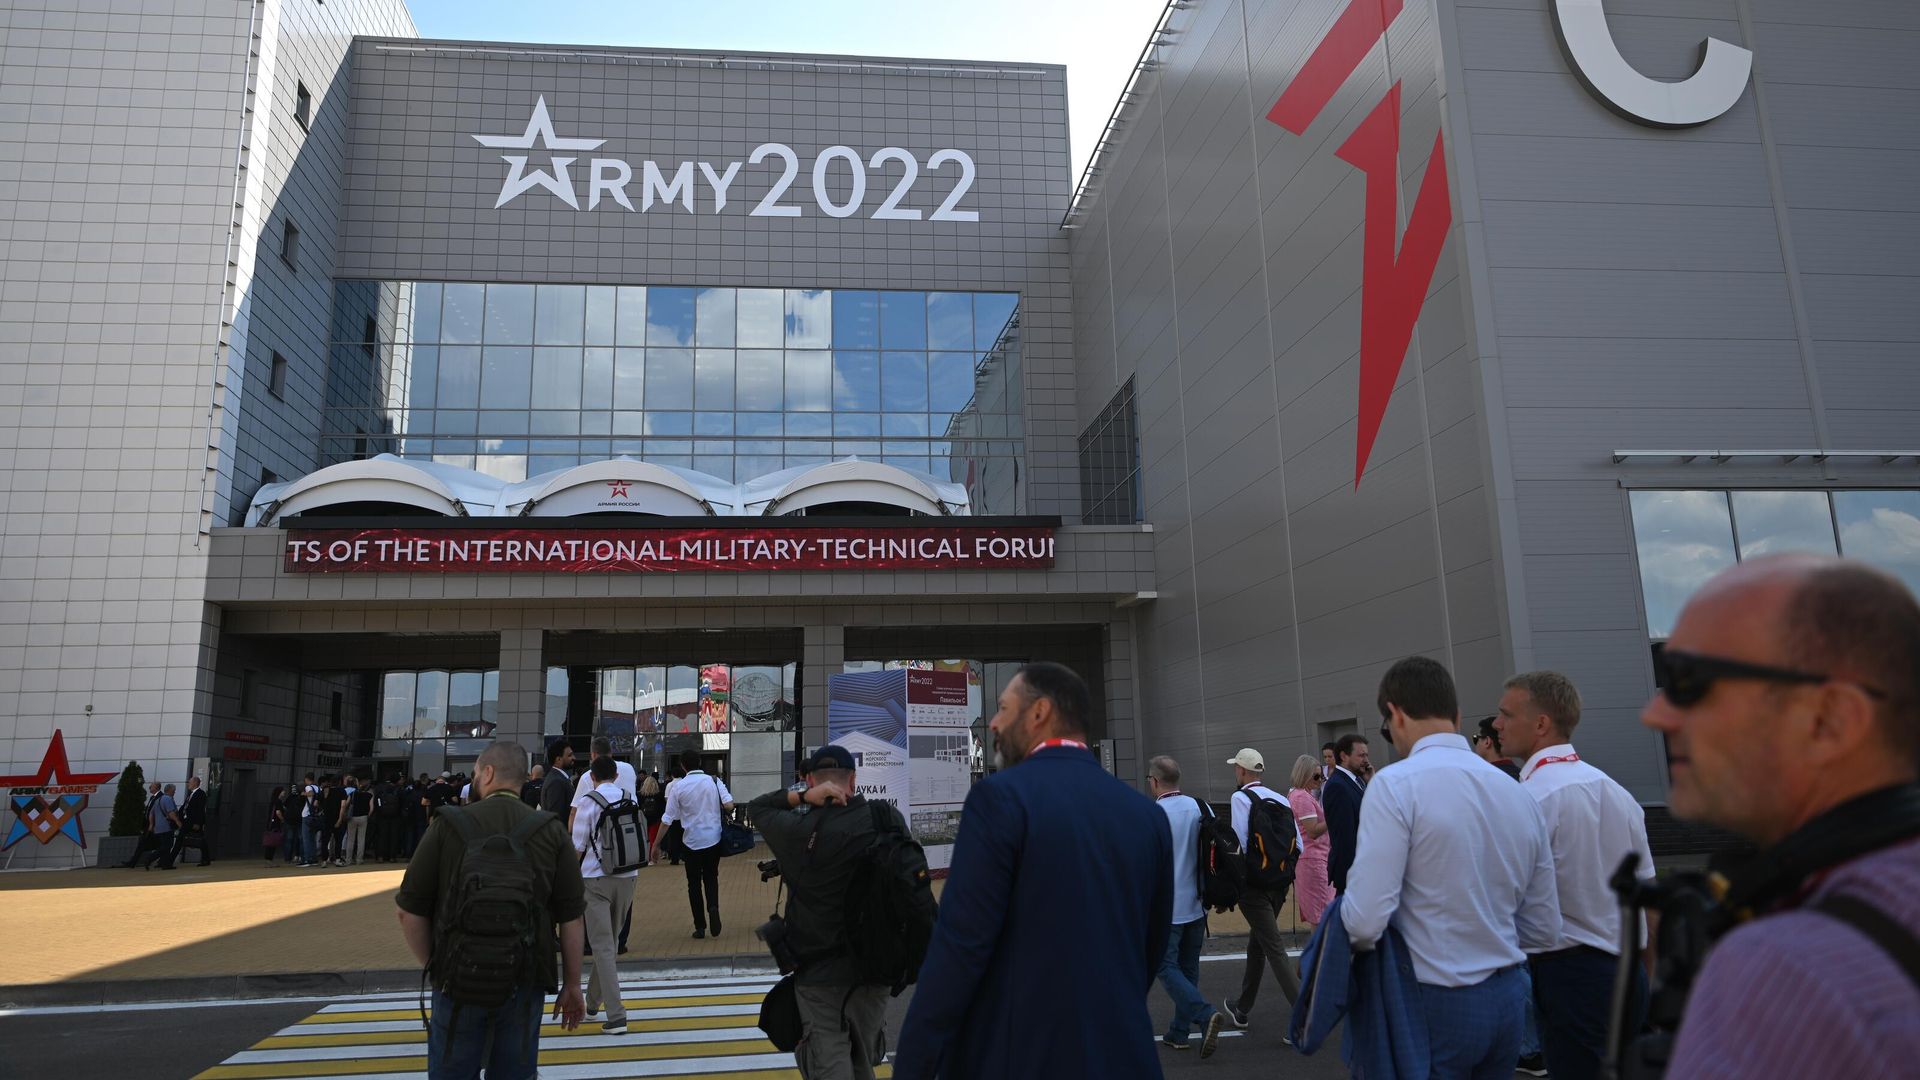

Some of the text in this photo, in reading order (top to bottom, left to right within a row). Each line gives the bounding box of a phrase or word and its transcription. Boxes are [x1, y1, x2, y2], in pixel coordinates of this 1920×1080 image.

[288, 540, 321, 563] TS
[328, 540, 368, 562] OF
[374, 539, 431, 562] THE
[439, 539, 673, 562] INTERNATIONAL
[680, 538, 970, 561] MILITARY-TECHNICAL
[880, 785, 887, 794] И
